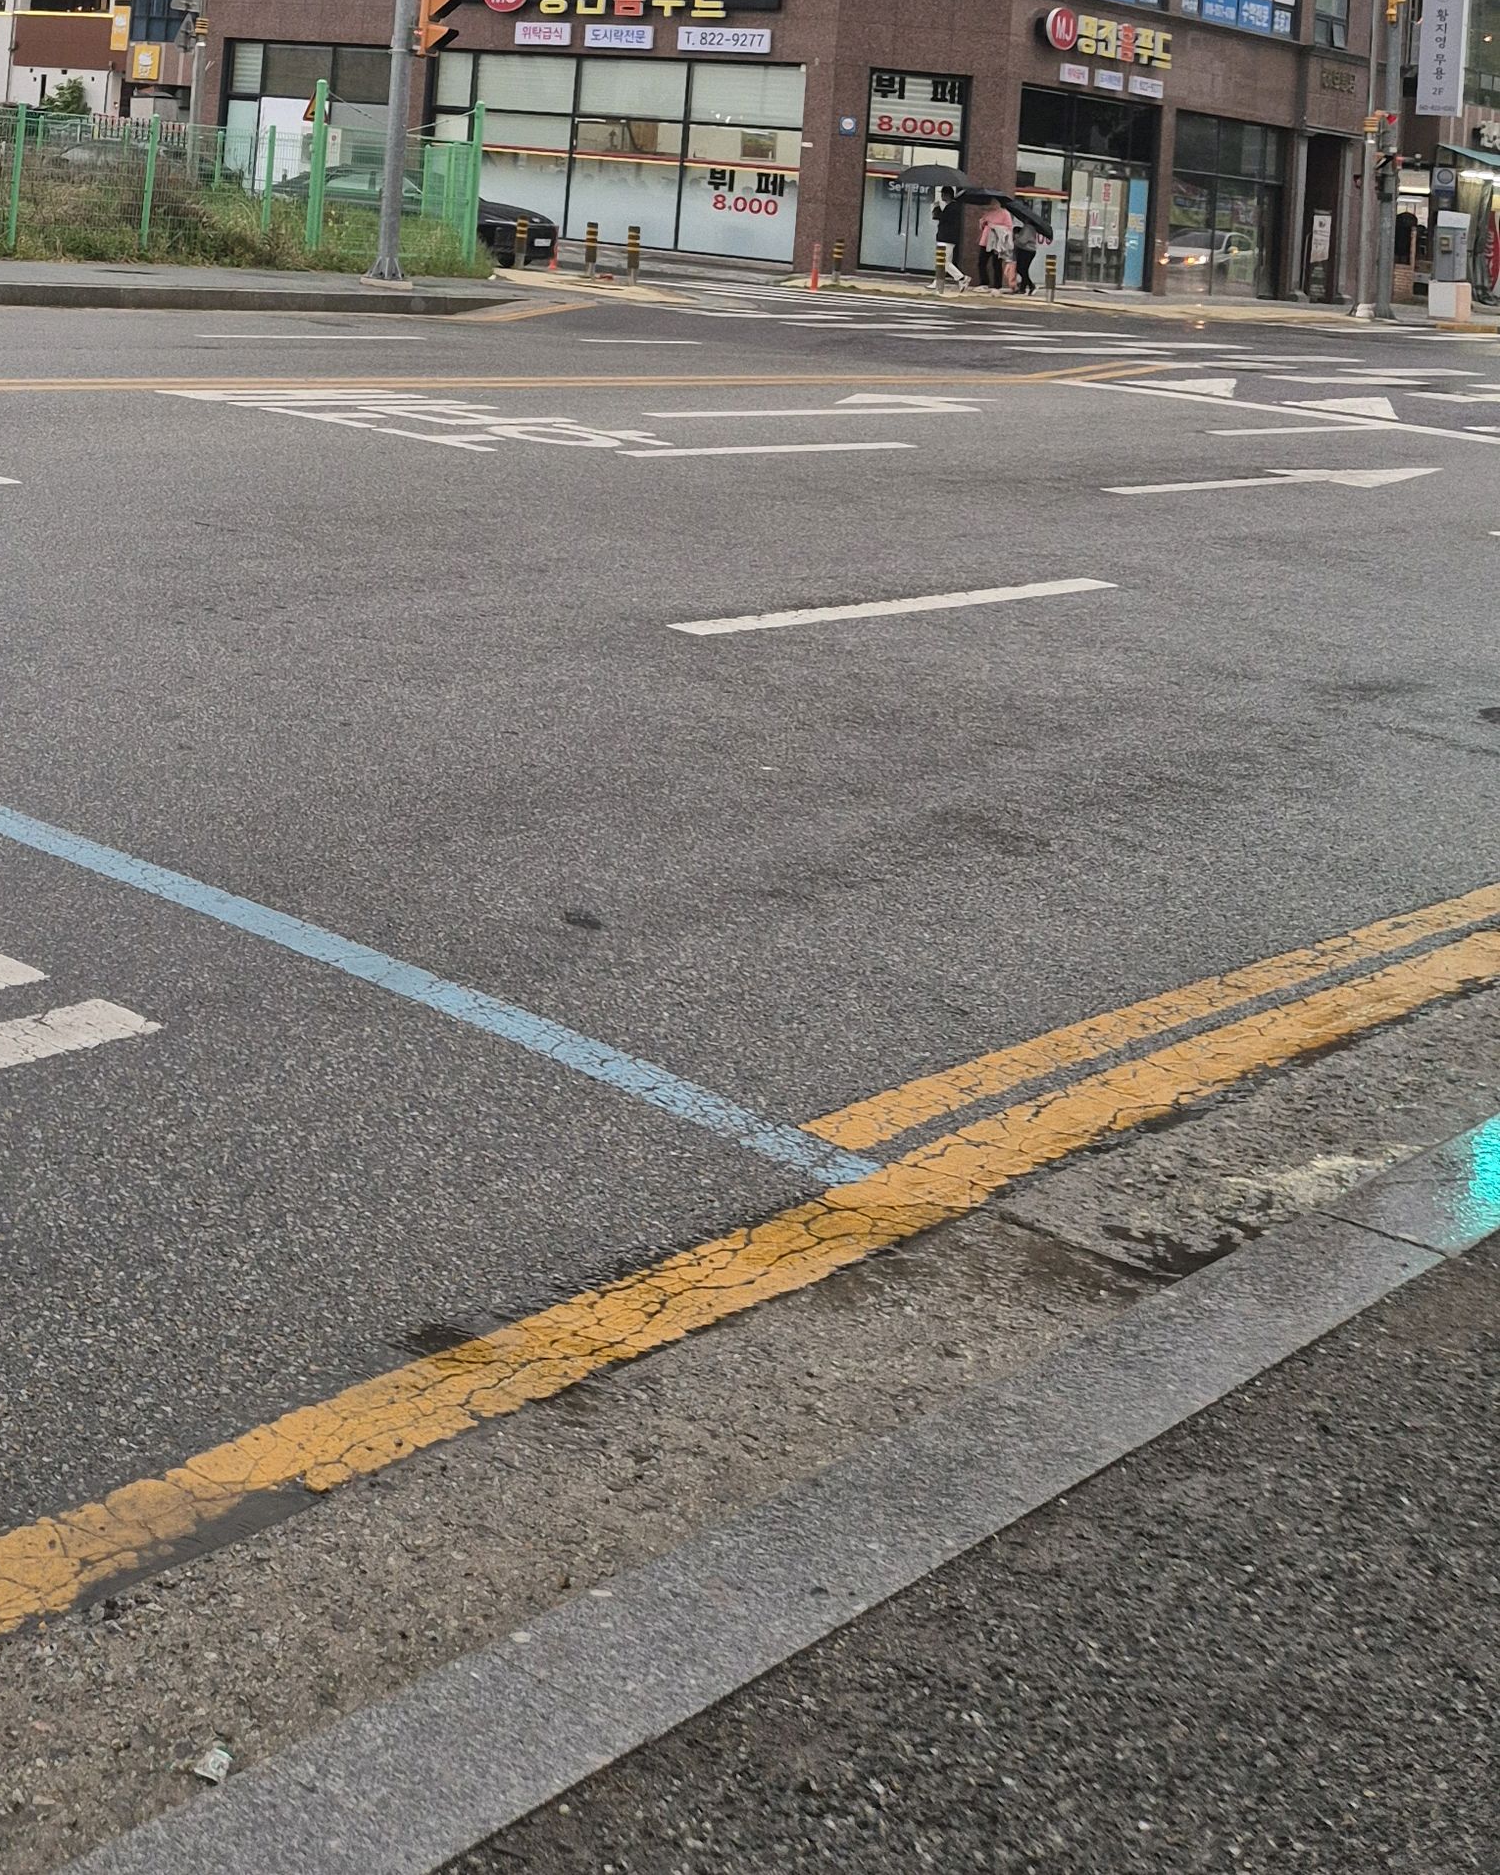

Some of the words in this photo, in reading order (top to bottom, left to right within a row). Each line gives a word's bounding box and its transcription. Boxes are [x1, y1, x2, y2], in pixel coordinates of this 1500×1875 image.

[522, 27, 564, 40] 위탁급식
[590, 29, 647, 44] 도시락전문
[1056, 15, 1073, 42] MJ
[700, 32, 765, 48] 822-9277
[1077, 14, 1173, 70] 명진홈푸드
